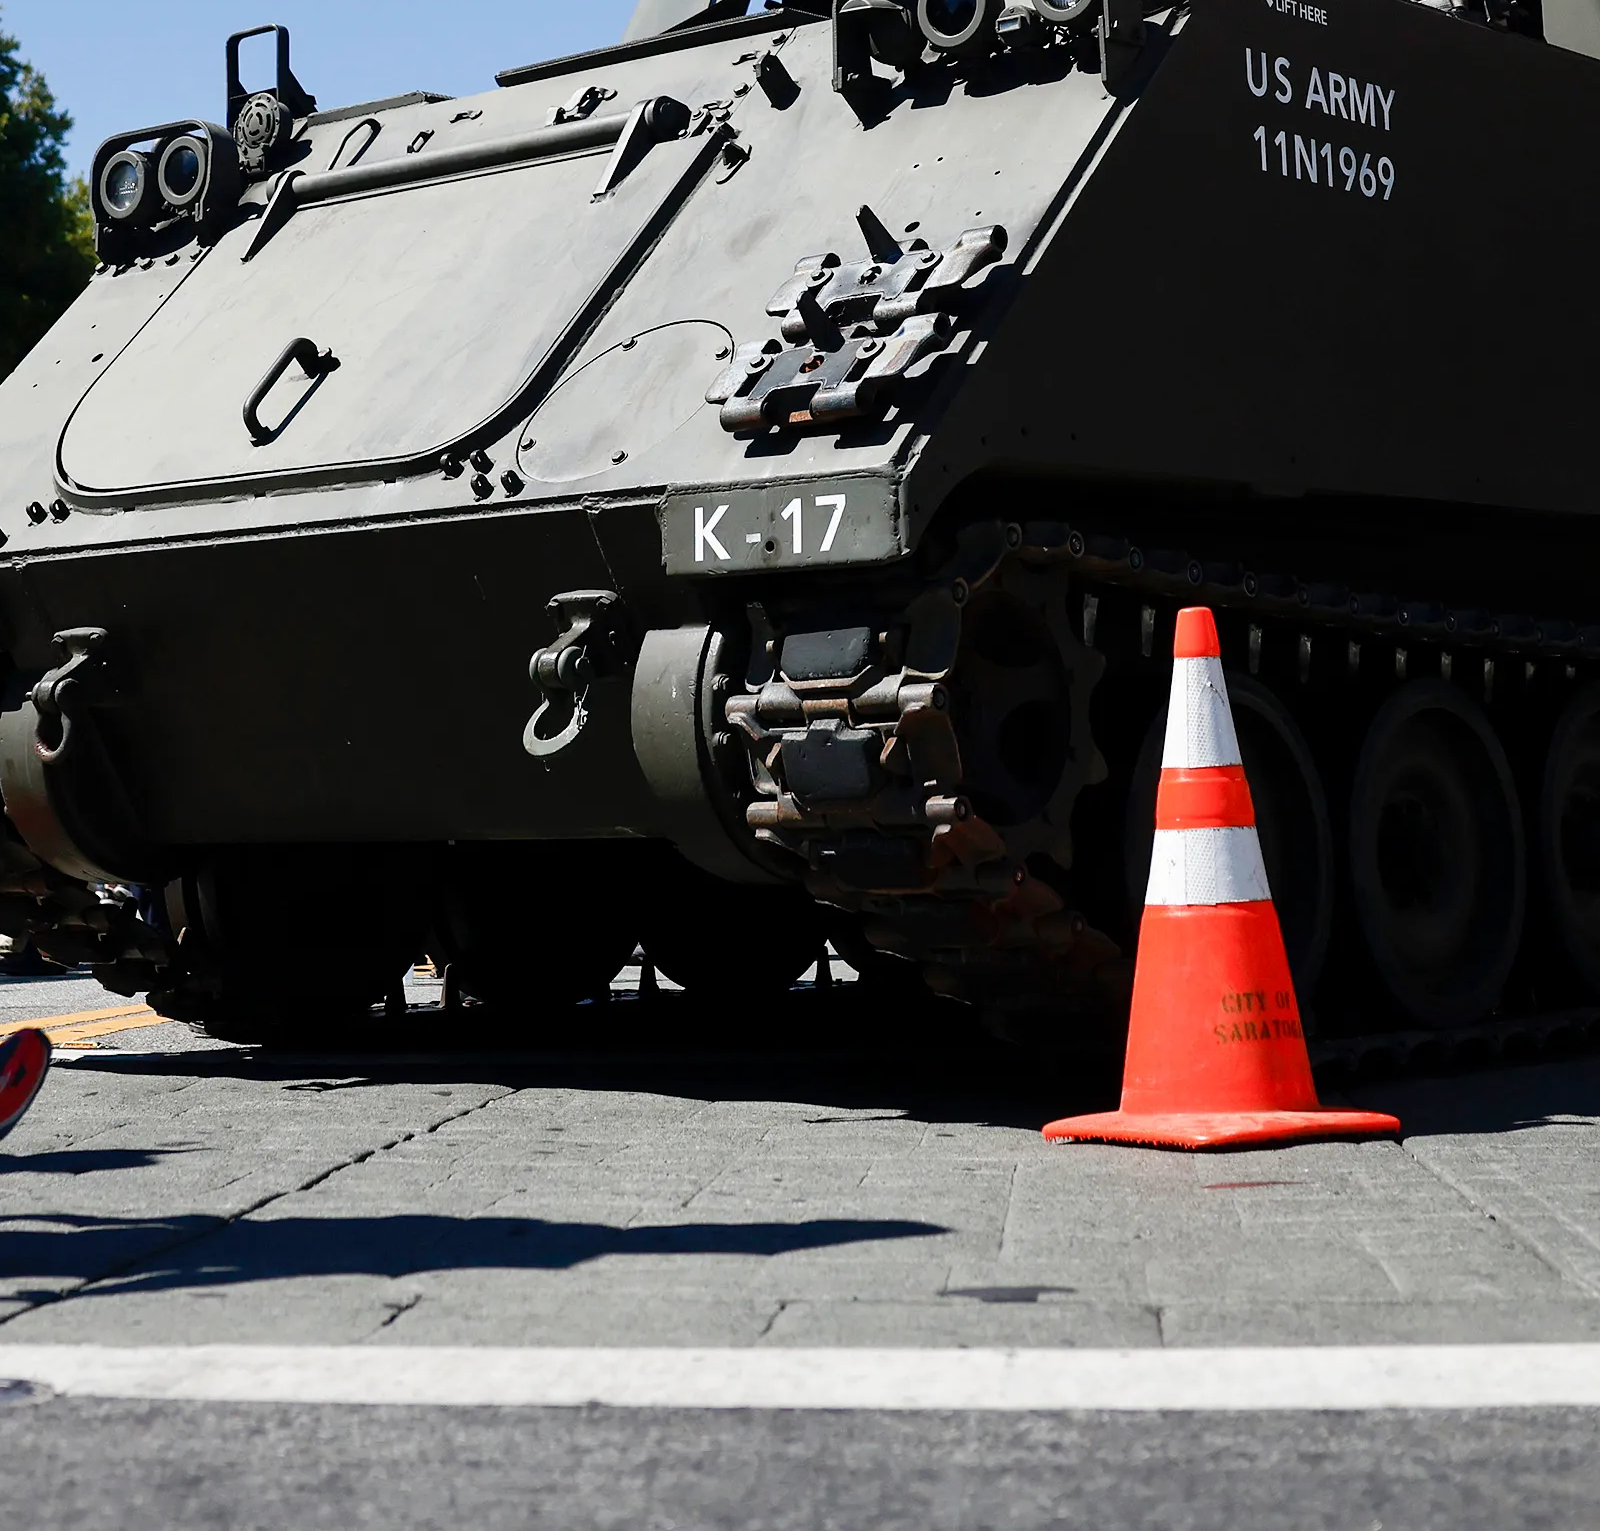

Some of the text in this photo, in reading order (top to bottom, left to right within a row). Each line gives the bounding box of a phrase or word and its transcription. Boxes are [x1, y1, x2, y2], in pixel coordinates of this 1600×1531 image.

[1299, 3, 1328, 26] HERE
[1245, 47, 1396, 131] US ARMY
[1253, 125, 1396, 201] 11N1969
[1222, 990, 1266, 1013] CITY
[1213, 1018, 1303, 1045] SARATOG
